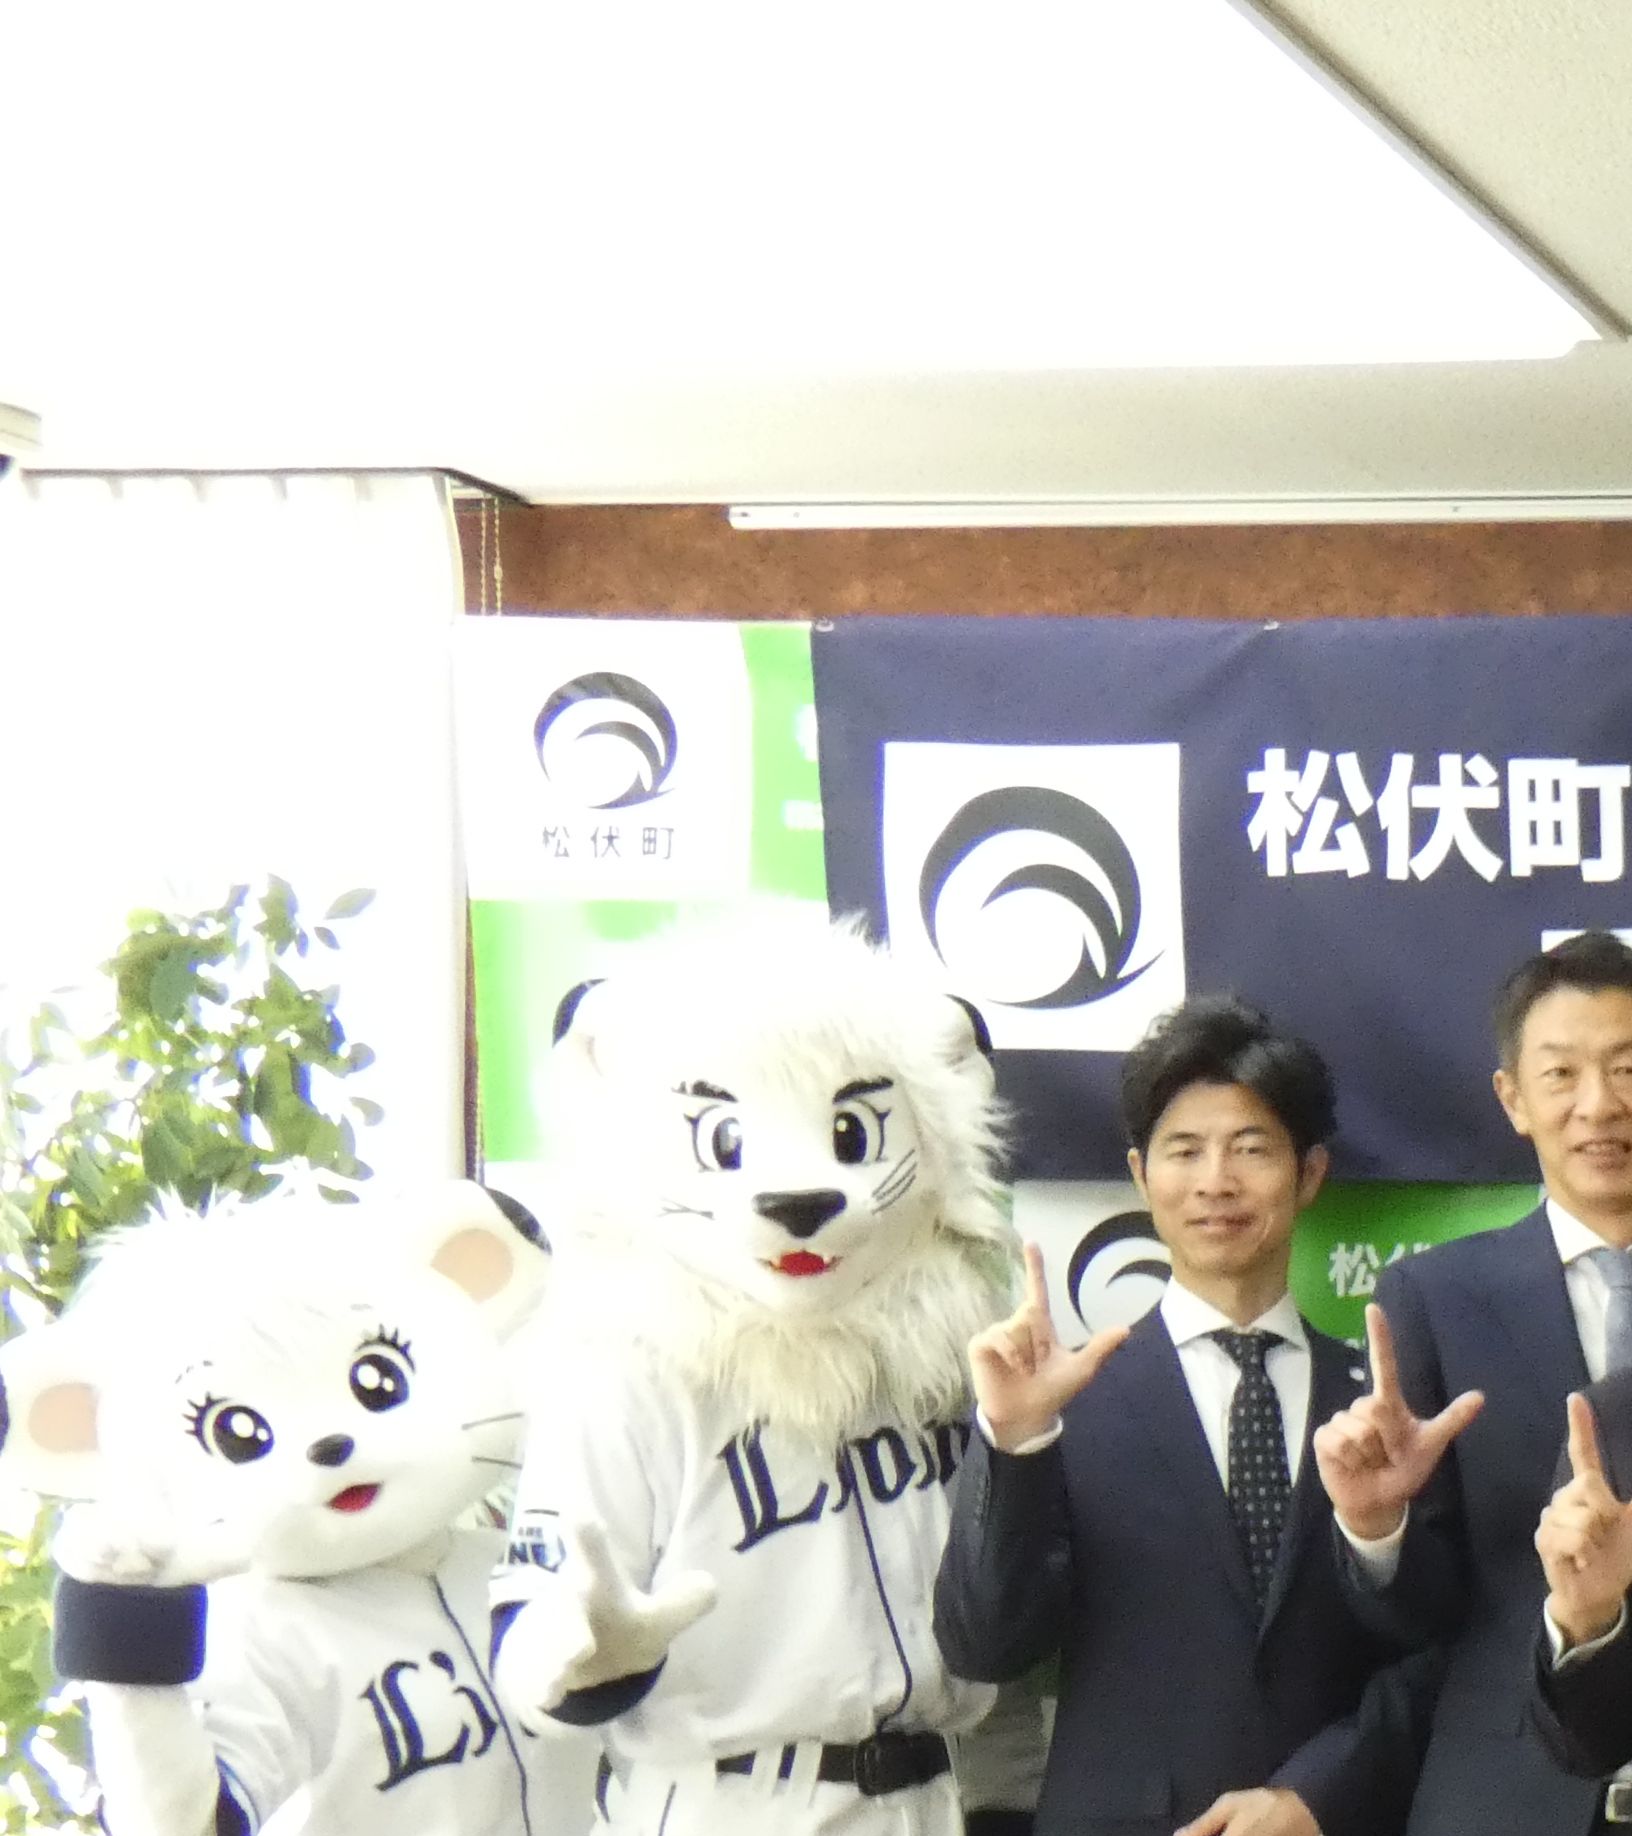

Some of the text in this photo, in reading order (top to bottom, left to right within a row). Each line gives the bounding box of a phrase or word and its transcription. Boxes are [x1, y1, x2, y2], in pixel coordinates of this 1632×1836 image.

[541, 823, 676, 861] 松伏町
[1246, 747, 1631, 882] 松伏町
[717, 1416, 973, 1553] Lion
